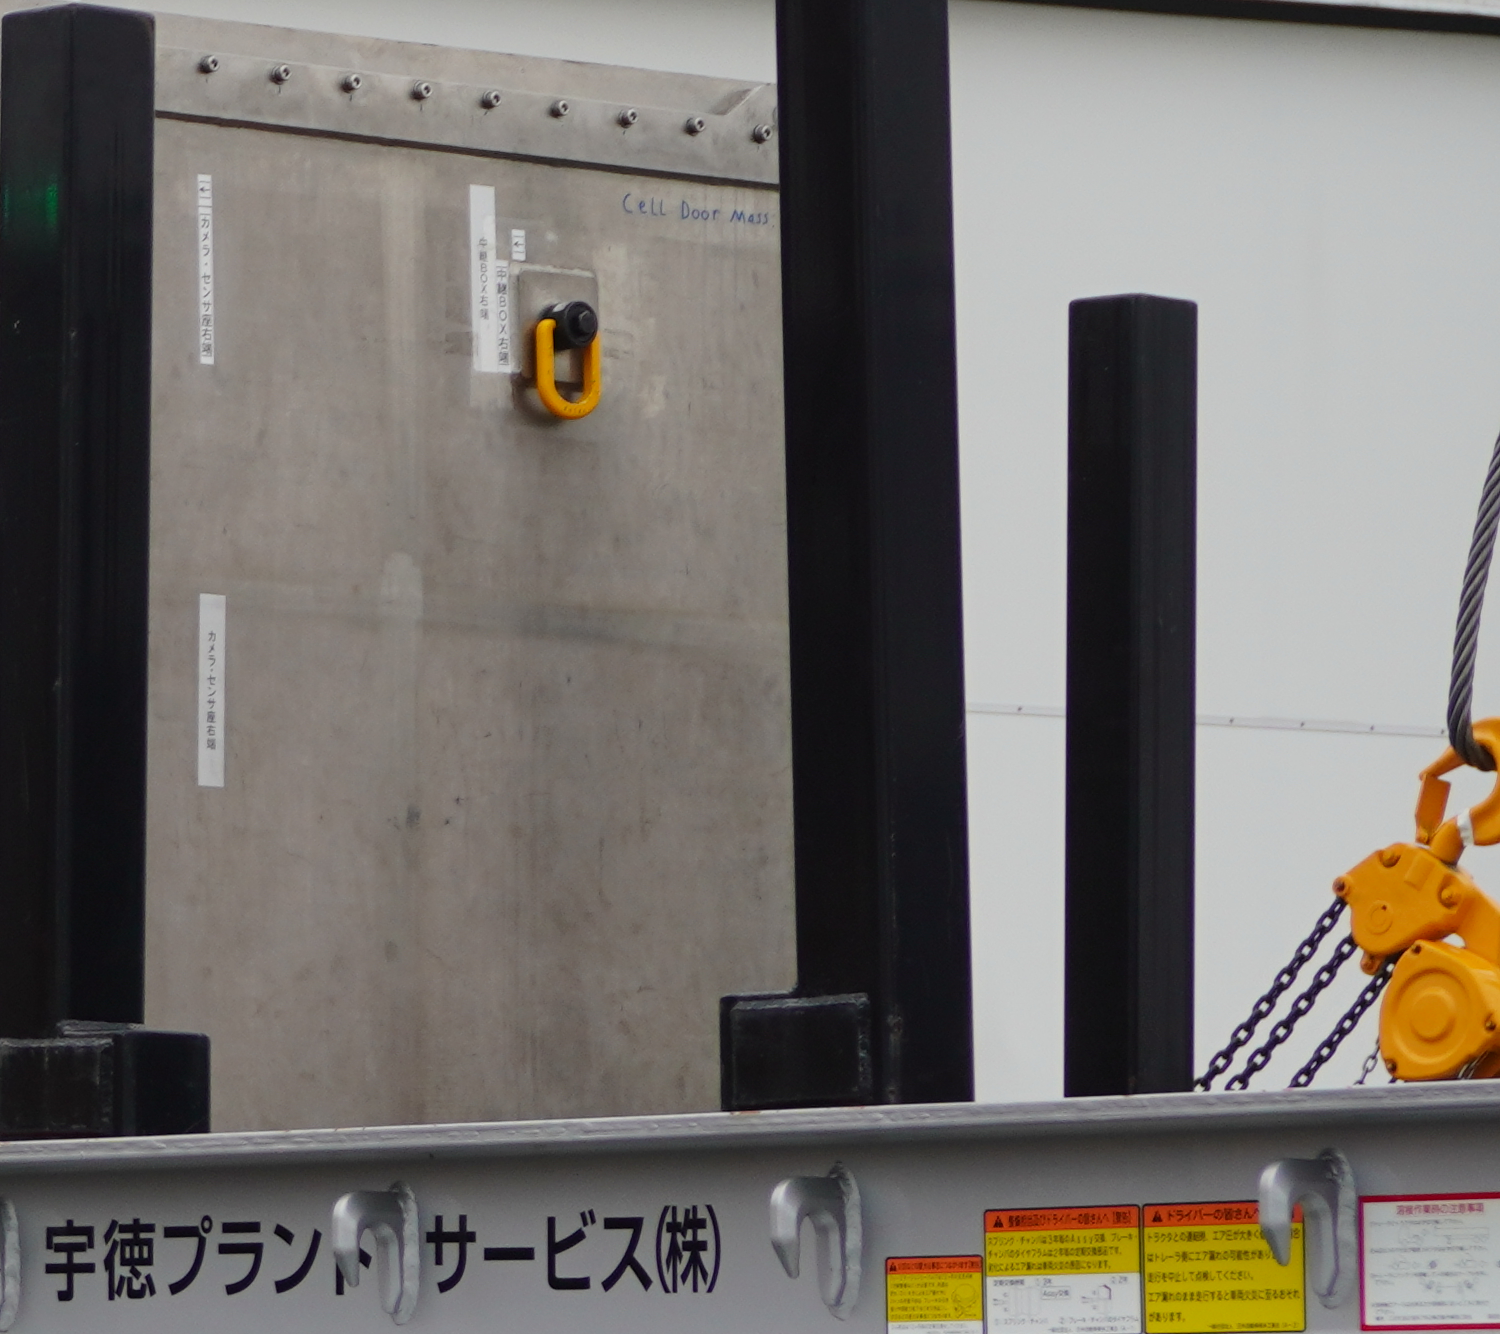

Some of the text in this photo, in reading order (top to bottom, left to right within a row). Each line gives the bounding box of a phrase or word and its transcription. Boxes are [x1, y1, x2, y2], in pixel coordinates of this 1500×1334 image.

[622, 193, 667, 217] Cell
[681, 200, 720, 222] Door
[206, 630, 217, 750] カメラ・センサ座右端
